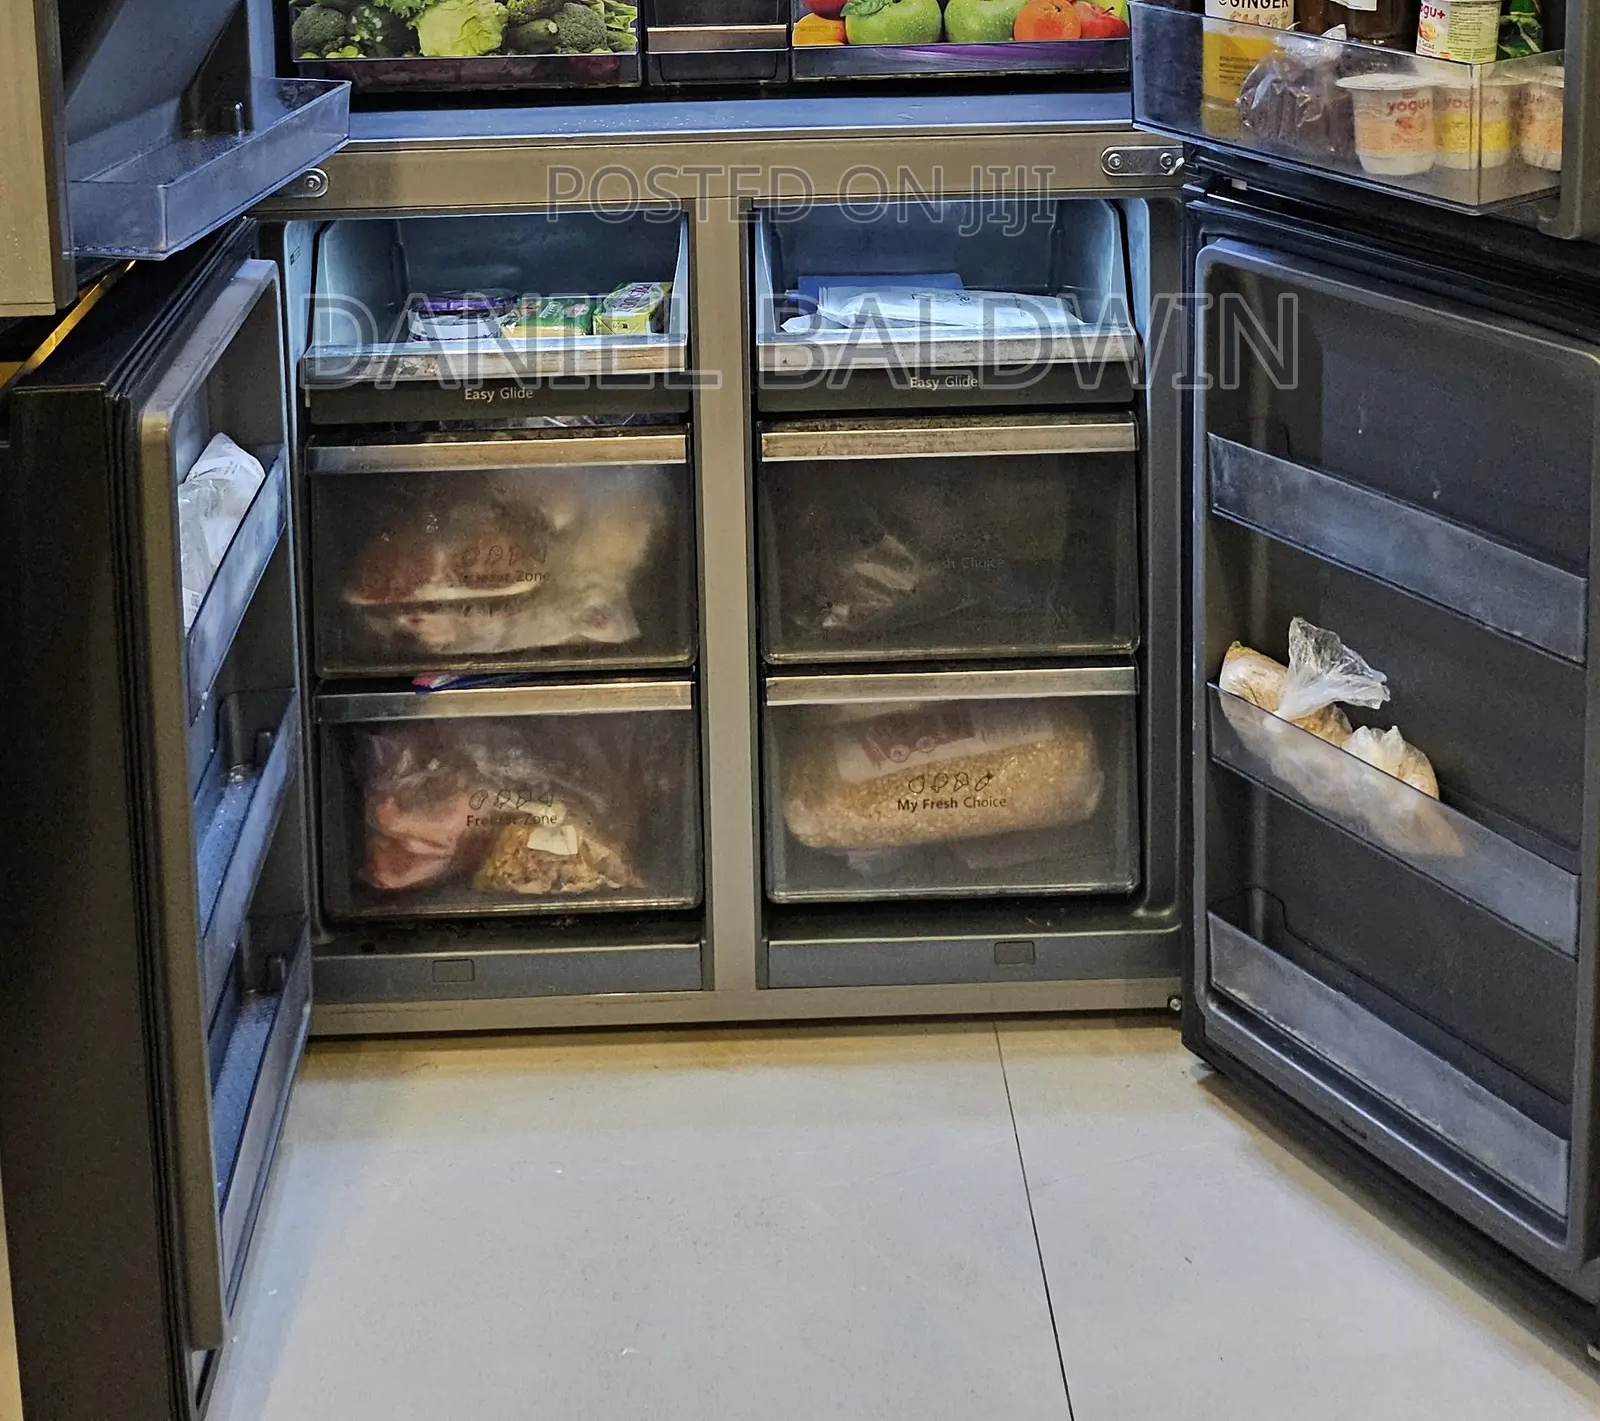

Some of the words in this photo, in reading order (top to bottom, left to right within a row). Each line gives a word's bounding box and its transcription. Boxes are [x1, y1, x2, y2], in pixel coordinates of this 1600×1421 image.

[1386, 96, 1431, 116] yogu+
[910, 376, 940, 391] Easy
[945, 376, 978, 387] Glide
[464, 387, 495, 403] Easy
[500, 387, 534, 399] Glide
[897, 799, 917, 813] My
[922, 796, 958, 810] Fresh
[963, 796, 1007, 808] Choice
[523, 813, 558, 826] Zone
